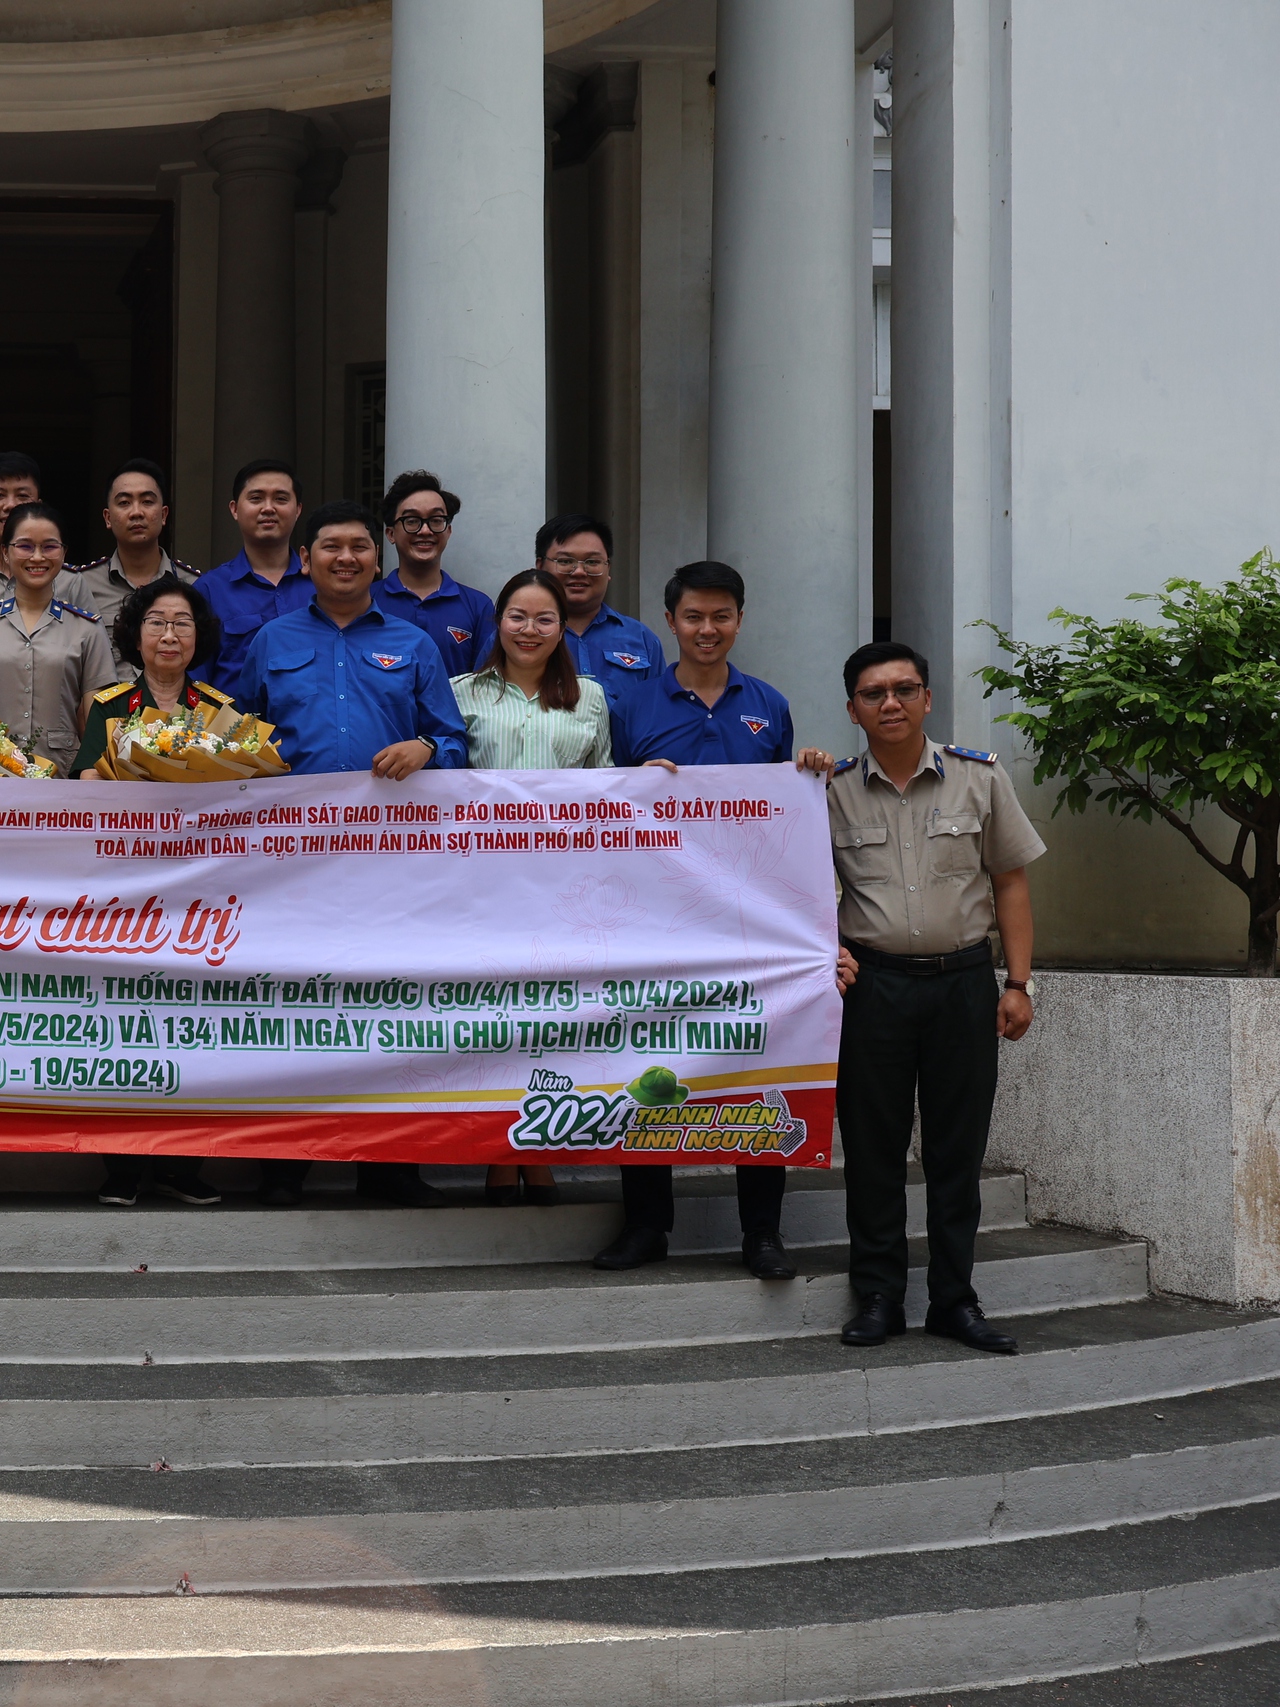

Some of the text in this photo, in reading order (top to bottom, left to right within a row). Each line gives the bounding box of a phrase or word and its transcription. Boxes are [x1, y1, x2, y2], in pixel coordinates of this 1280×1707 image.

[35, 810, 93, 829] PHÒNG
[99, 810, 155, 830] THÀNH
[160, 807, 183, 830] UỶ
[197, 808, 253, 829] PHÒNG
[257, 803, 304, 825] CẢNH
[308, 803, 341, 825] SÁT
[343, 805, 381, 823] GIAO
[385, 800, 439, 821] THÔNG
[455, 798, 488, 821] BÁO
[494, 798, 544, 820] NGƯỜI
[550, 803, 583, 820] LAO
[585, 798, 633, 823] ĐỘNG
[654, 796, 677, 819] SỞ
[682, 798, 715, 819] XÂY
[720, 799, 768, 823] DỰNG
[95, 836, 126, 856] TOÀ
[132, 835, 156, 856] ÁN
[160, 836, 206, 856] NHÂN
[211, 835, 245, 854] DÂN
[263, 836, 295, 857] CỤC
[301, 835, 324, 853] THI
[329, 832, 373, 852] HÀNH
[379, 831, 402, 852] ÁN
[407, 830, 442, 851] DÂN
[447, 831, 471, 853] SỰ
[477, 828, 528, 850] THÀNH
[535, 826, 570, 850] PHỐ
[573, 826, 598, 850] HỒ
[601, 827, 630, 849] CHÍ
[635, 829, 680, 849] MINH
[38, 893, 168, 943] chính
[173, 894, 243, 955] trị
[22, 972, 93, 1001] NAM,
[102, 971, 192, 1000] THỐNG
[202, 973, 276, 1002] NHẤT
[282, 973, 335, 1003] ĐẤT
[343, 976, 418, 1003] NƯỚC
[429, 979, 574, 1008] (30/4/1975
[606, 979, 759, 1010] 30/4/2024),
[118, 1009, 153, 1043] VÀ
[163, 1016, 212, 1044] 134
[221, 1011, 284, 1045] NĂM
[295, 1013, 369, 1048] NGÀY
[378, 1019, 444, 1048] SINH
[454, 1011, 513, 1049] CHỦ
[517, 1020, 577, 1052] TỊCH
[586, 1012, 624, 1050] HỒ
[631, 1015, 680, 1050] CHÍ
[687, 1020, 762, 1050] MINH
[30, 1056, 175, 1090] 19/5/2024)
[529, 1070, 573, 1092] Năm
[518, 1098, 624, 1141] 2024
[635, 1102, 780, 1126] THANH NIÊN
[624, 1129, 680, 1149] TÌNH
